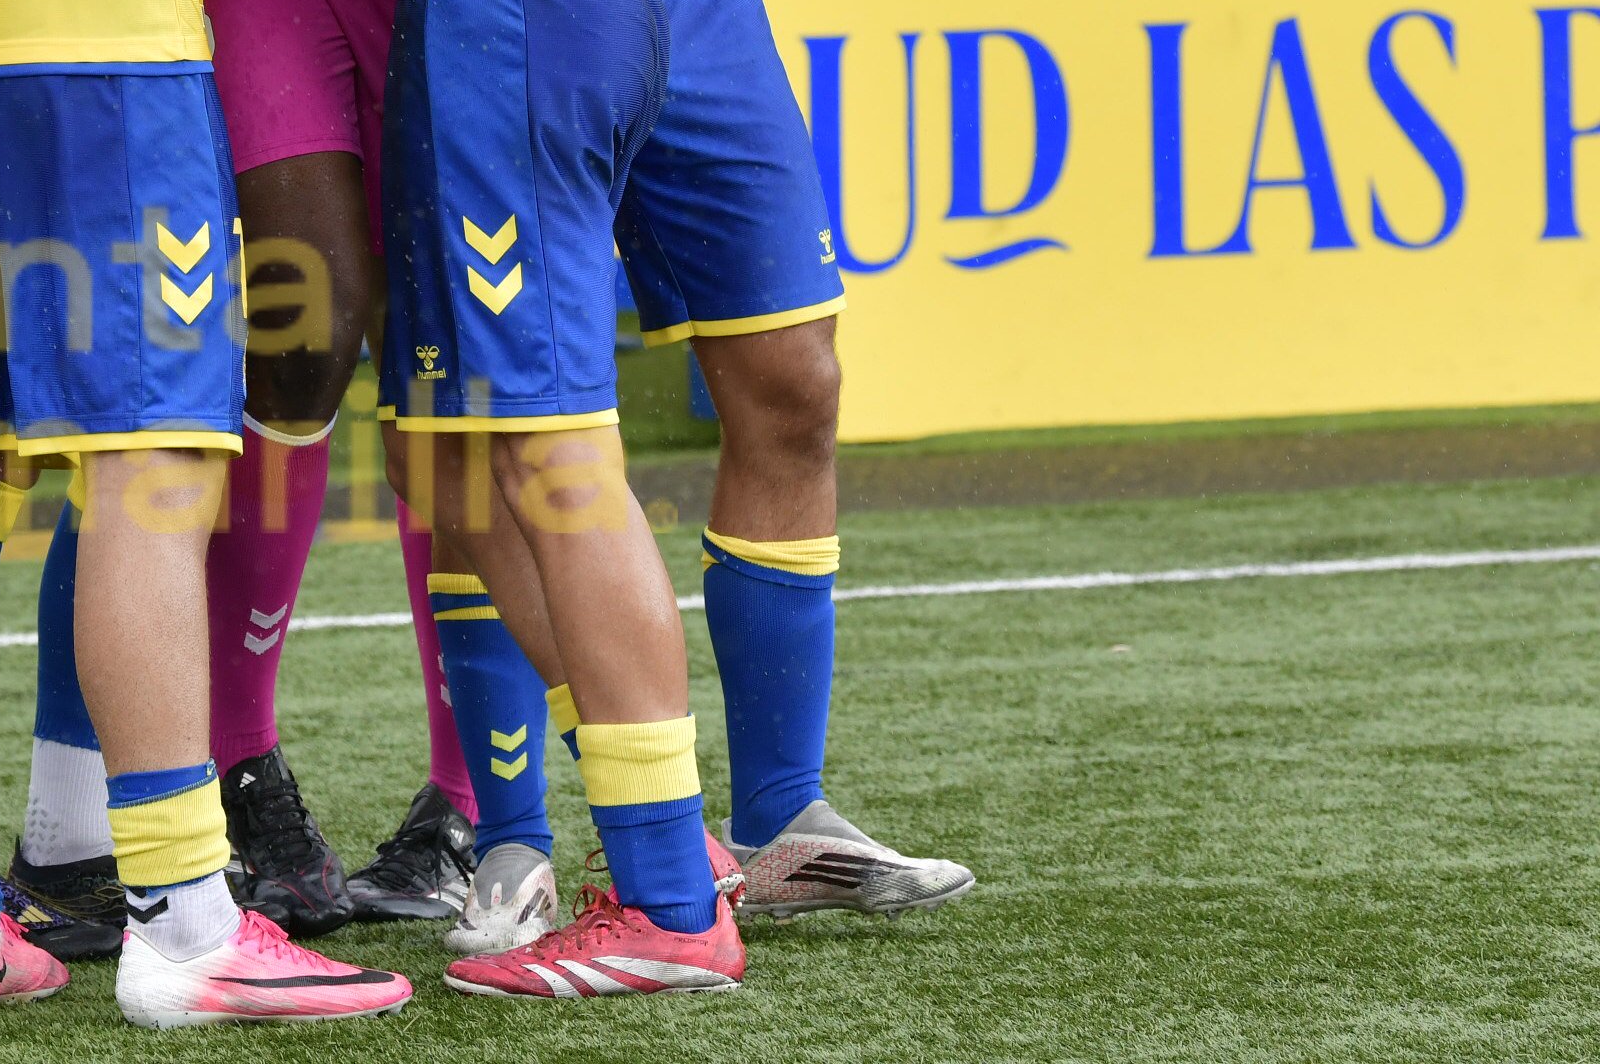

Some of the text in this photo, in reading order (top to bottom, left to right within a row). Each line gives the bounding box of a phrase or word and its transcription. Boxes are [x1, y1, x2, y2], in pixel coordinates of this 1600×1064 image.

[802, 25, 1070, 274] UD
[1141, 8, 1467, 260] LAS
[416, 367, 448, 380] hummel
